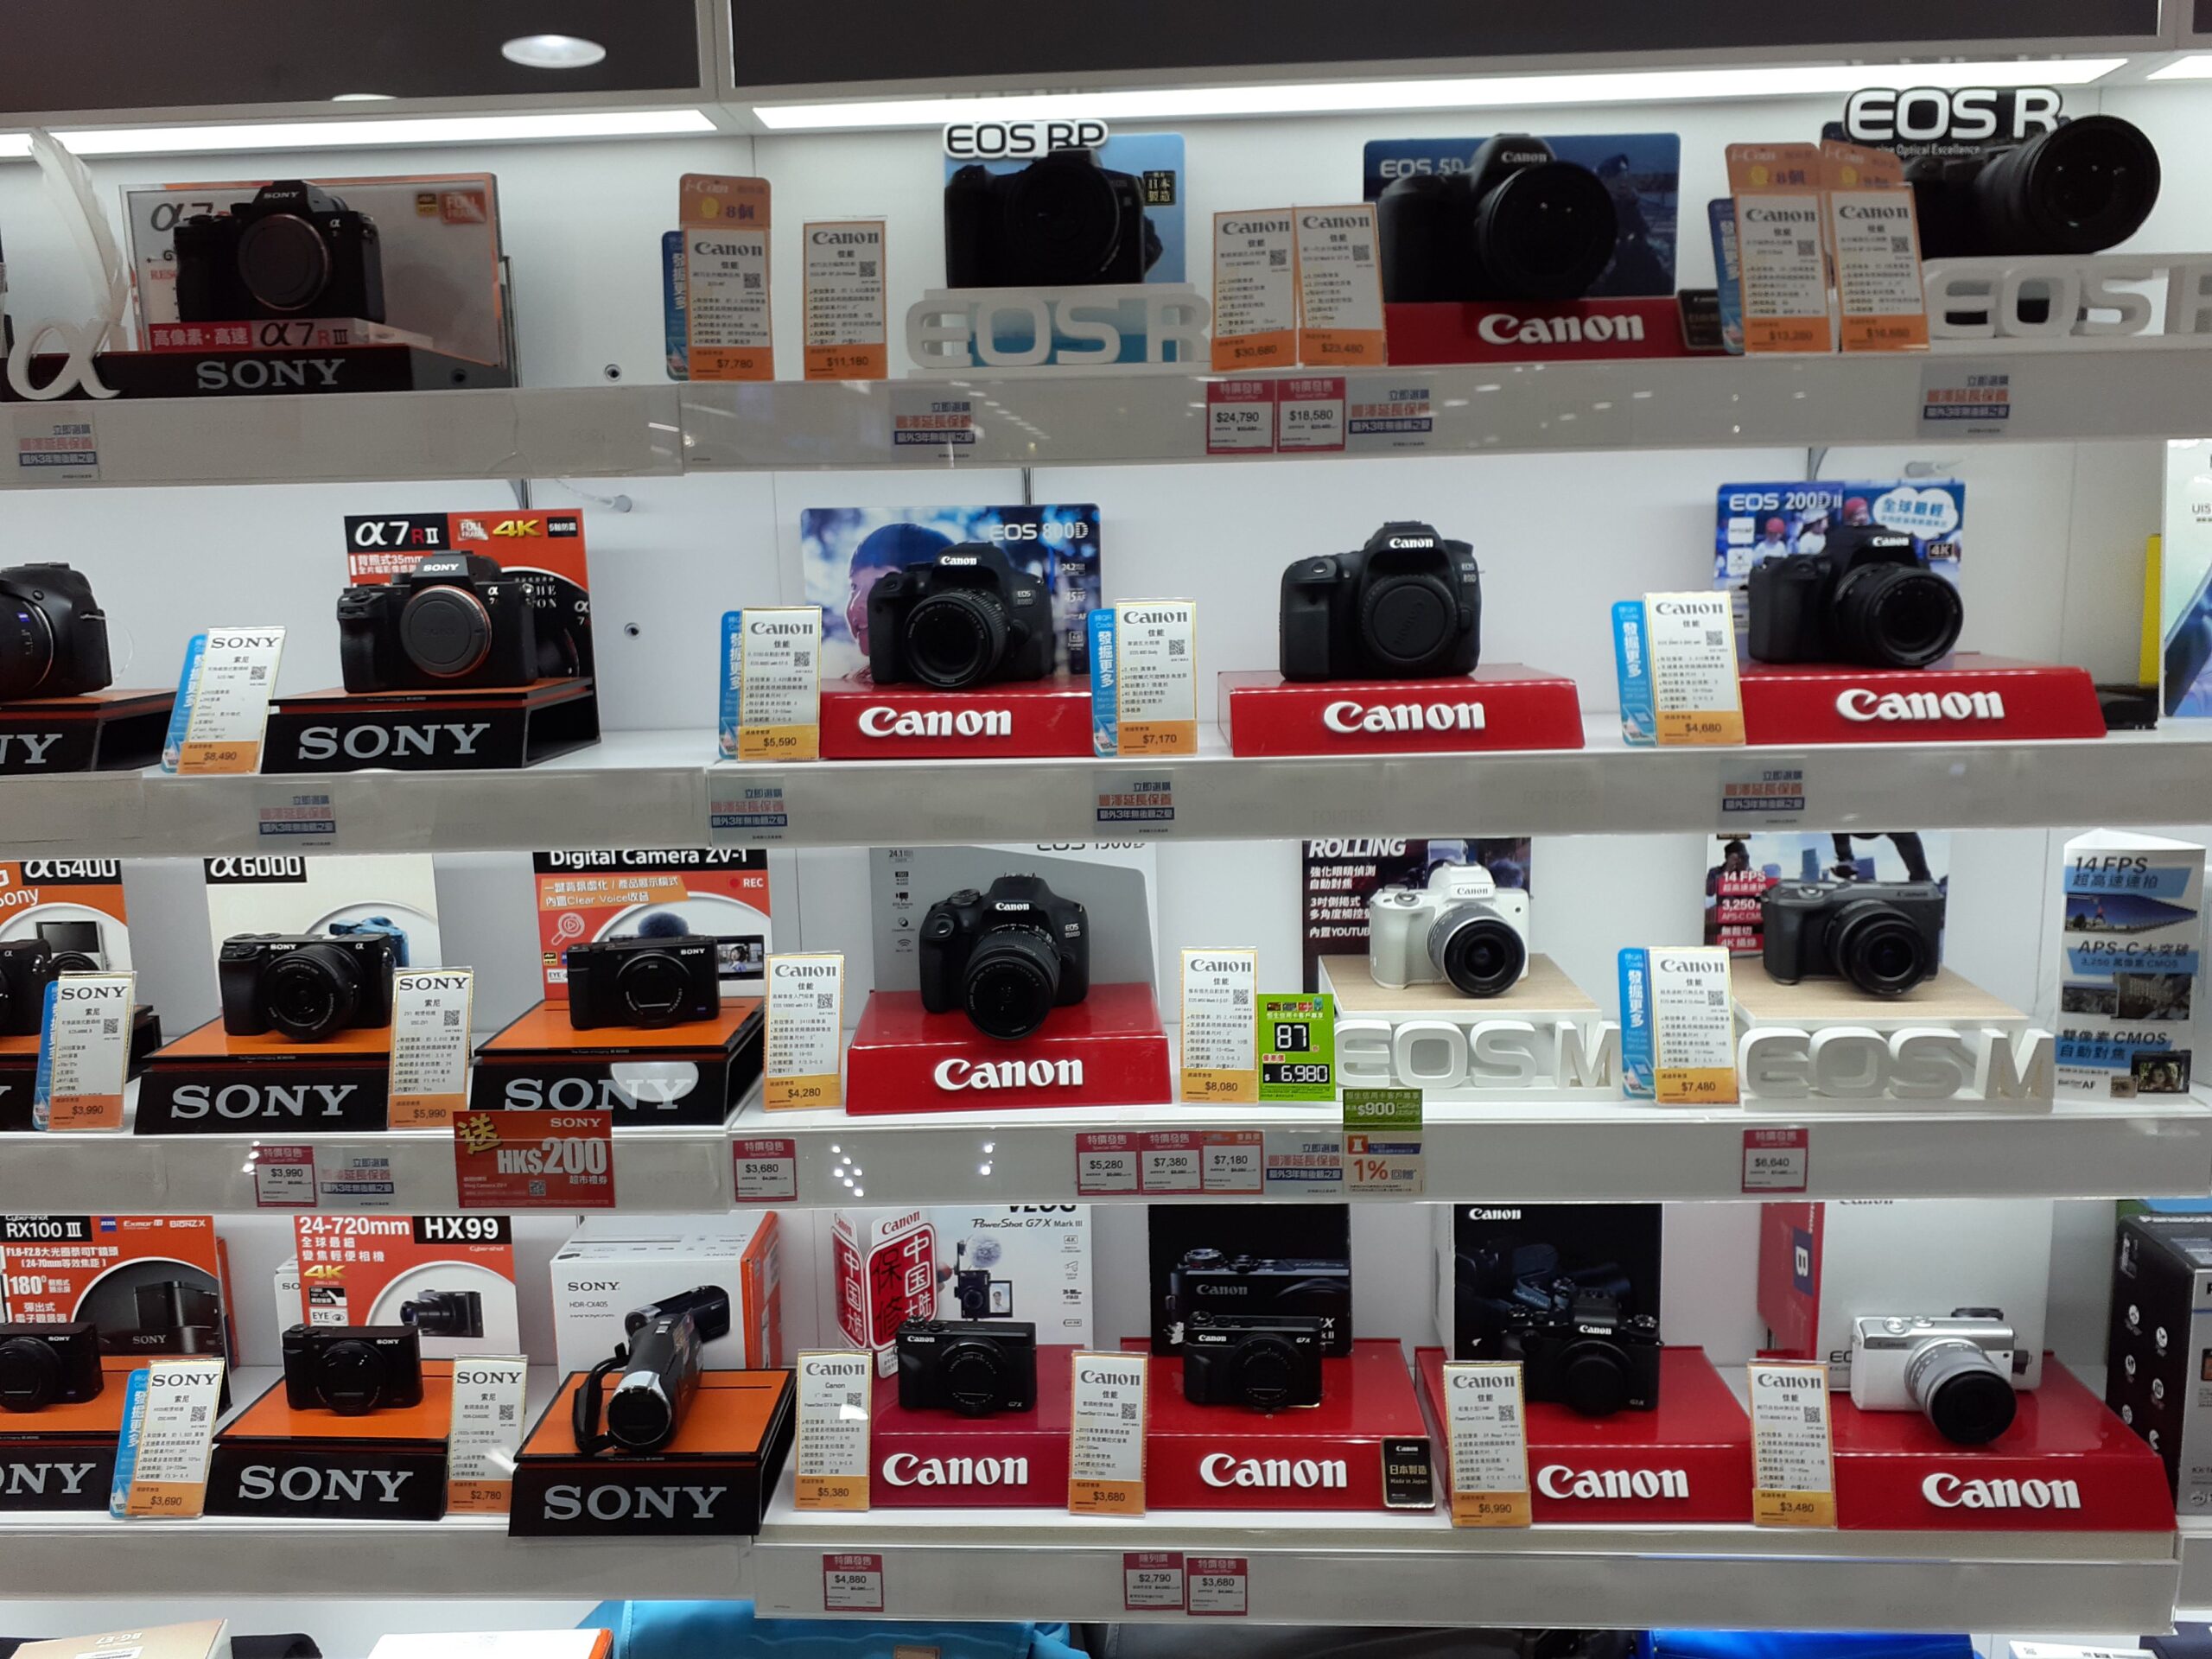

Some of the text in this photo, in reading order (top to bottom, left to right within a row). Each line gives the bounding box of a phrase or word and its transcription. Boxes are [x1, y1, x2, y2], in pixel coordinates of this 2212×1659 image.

[1848, 89, 2062, 139] EOS R
[947, 123, 1104, 153] EOS RP
[1896, 143, 1980, 156] Optical Excellence
[1502, 151, 1548, 163] Canon
[1380, 158, 1463, 178] EOS 5D
[264, 191, 299, 200] SONY
[1840, 205, 1909, 220] Canon
[1223, 221, 1291, 235] Canon
[1302, 215, 1370, 230] Canon
[812, 231, 879, 245] Canon
[695, 242, 763, 257] Canon
[906, 298, 1121, 369] EOS
[1146, 293, 1211, 363] R
[1478, 313, 1644, 344] Canon
[717, 358, 753, 369] $7,780
[827, 356, 868, 367] $11,180
[196, 359, 345, 390] SONY
[1219, 381, 1263, 395] 特價發售
[1217, 411, 1259, 424] $24,790
[1289, 410, 1333, 422] $18,580
[1729, 493, 1779, 511] EOS
[1785, 491, 1831, 511] 200D
[493, 518, 543, 537] 4K
[990, 522, 1089, 540] EOS 800D
[1389, 537, 1434, 549] Canon
[1930, 543, 1953, 557] 4K
[941, 555, 977, 566] Canon
[423, 563, 460, 572] SONY
[1656, 602, 1724, 615] Canon
[1123, 610, 1188, 625] Canon
[751, 622, 814, 635] Canon
[1148, 628, 1165, 638] 佳能
[210, 637, 282, 649] SONY
[1098, 630, 1115, 689] 發掘更多
[1835, 688, 2005, 721] Canon
[859, 706, 1012, 737] Canon
[1324, 701, 1486, 733] Canon
[1685, 722, 1722, 734] $4,680
[298, 722, 490, 760] SONY
[764, 736, 798, 747] $5,590
[1143, 733, 1178, 745] $7,170
[204, 750, 238, 762] $8,490
[1309, 838, 1408, 857] ROLLING
[550, 849, 748, 869] Digital Camera ZV-1
[2075, 856, 2148, 874] 14 FPS
[743, 878, 764, 887] REC
[1724, 870, 1767, 882] 14 FPS
[1309, 878, 1353, 891] 自動對焦
[995, 902, 1030, 912] Canon
[2079, 941, 2139, 957] APS-C
[775, 964, 837, 978] Canon
[1190, 958, 1252, 972] Canon
[1660, 959, 1725, 973] Canon
[399, 976, 469, 990] SONY
[798, 982, 815, 991] 佳能
[1213, 977, 1230, 986] 佳能
[61, 986, 128, 1001] SONY
[1627, 969, 1644, 1028] 發掘更多
[1277, 1025, 1308, 1049] 87
[2113, 1031, 2167, 1045] CMOS
[1335, 1020, 1536, 1089] EOS
[1556, 1020, 1622, 1089] M
[2060, 1045, 2126, 1061] 自動對焦
[1738, 1027, 1962, 1099] EOS
[1974, 1028, 2055, 1100] M
[934, 1058, 1084, 1090] Canon
[788, 1087, 822, 1099] $4,280
[1205, 1081, 1238, 1092] $8,080
[1681, 1081, 1716, 1093] $7,480
[505, 1077, 691, 1111] SONY
[171, 1084, 358, 1119] SONY
[72, 1104, 104, 1116] $3,990
[413, 1109, 446, 1119] $5,990
[1357, 1102, 1395, 1116] $900
[457, 1112, 601, 1155] 送 SONY
[1087, 1135, 1128, 1145] 特價發售
[1150, 1134, 1190, 1145] 特價發售
[745, 1141, 785, 1152] 特價發售
[1090, 1160, 1123, 1171] $5,280
[1154, 1156, 1188, 1167] $7,380
[1214, 1154, 1248, 1166] $7,180
[1755, 1157, 1790, 1168] $6,640
[271, 1168, 304, 1179] $3,990
[745, 1163, 779, 1174] $3,680
[1353, 1159, 1389, 1183] 1%
[1469, 1209, 1522, 1221] Canon
[299, 1217, 499, 1239] 24-720mm HX99
[972, 1217, 1023, 1229] PowerShot
[6, 1223, 83, 1238] RX100 III
[301, 1236, 356, 1249] 全球最細
[302, 1250, 385, 1262] 變焦輕便相機
[304, 1264, 346, 1279] 4K
[568, 1281, 620, 1293] SONY
[569, 1300, 609, 1309] HDR-CX405
[312, 1311, 330, 1321] EYE
[1580, 1325, 1612, 1335] Canon
[132, 1334, 167, 1345] SONY
[806, 1362, 866, 1376] Canon
[151, 1373, 219, 1388] SONY
[456, 1370, 523, 1384] SONY
[1080, 1370, 1141, 1387] Canon
[1453, 1374, 1516, 1389] Canon
[1758, 1373, 1822, 1389] Canon
[174, 1395, 190, 1403] 索尼
[480, 1392, 497, 1402] 索尼
[1103, 1390, 1119, 1399] 佳能
[882, 1452, 1028, 1487] Canon
[1200, 1452, 1348, 1488] Canon
[1389, 1464, 1427, 1476] 日本製造
[238, 1465, 413, 1503] SONY
[1412, 1478, 1427, 1486] Japan
[1536, 1465, 1689, 1500] Canon
[471, 1490, 502, 1501] $2,780
[817, 1487, 849, 1498] $5,380
[1093, 1491, 1126, 1503] $3,680
[1922, 1471, 2081, 1510] Canon
[150, 1495, 182, 1507] $3,690
[543, 1484, 727, 1520] SONY
[1780, 1501, 1815, 1514] $3,480
[1478, 1503, 1512, 1514] $6,990
[835, 1573, 867, 1585] $4,880
[1139, 1573, 1172, 1584] $2,790
[1202, 1577, 1235, 1588] $3,680
